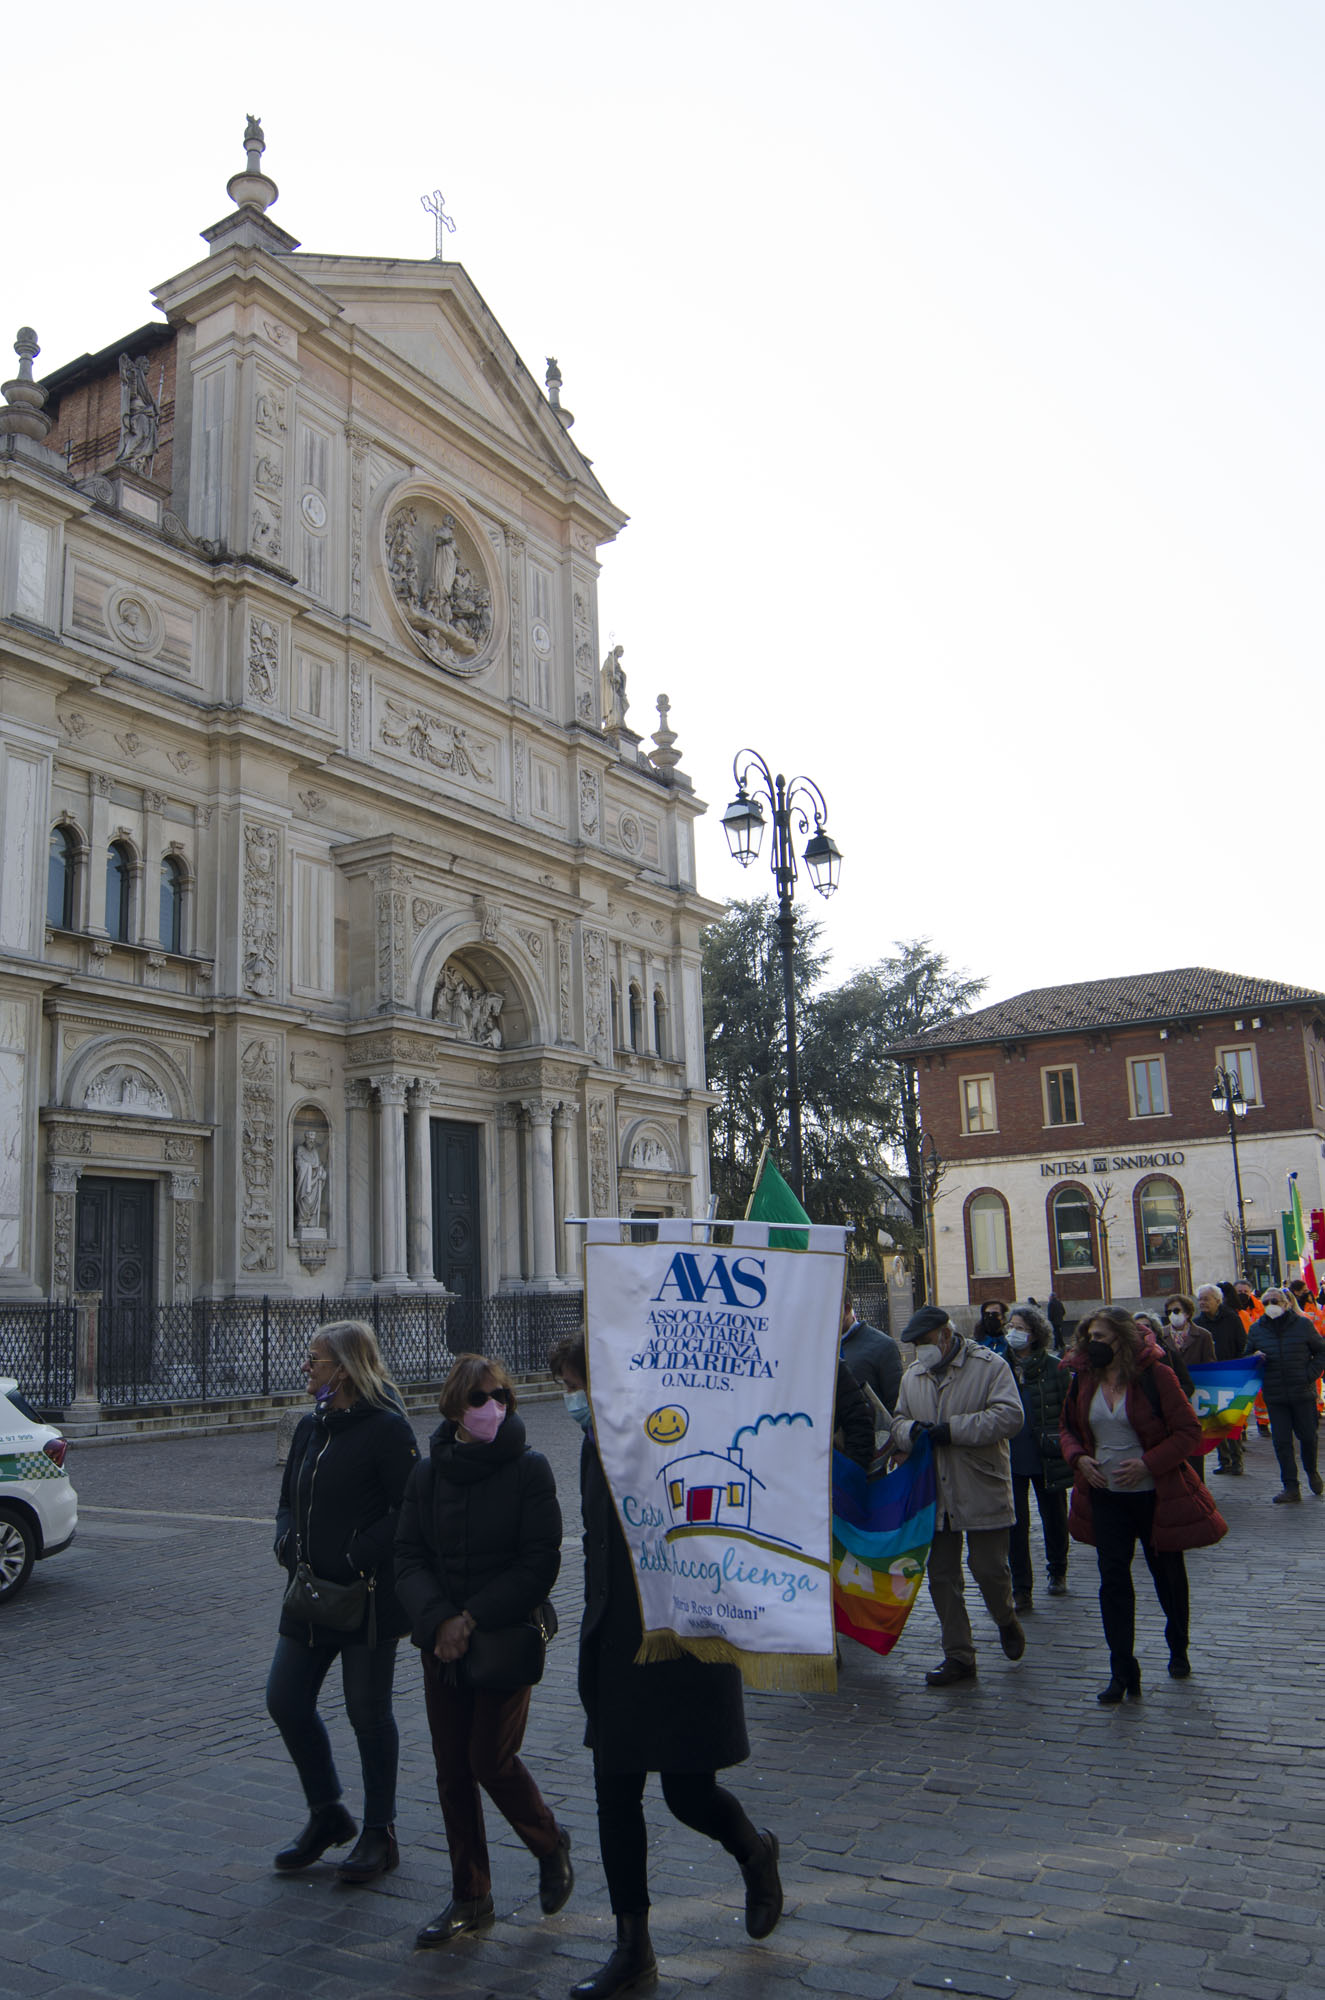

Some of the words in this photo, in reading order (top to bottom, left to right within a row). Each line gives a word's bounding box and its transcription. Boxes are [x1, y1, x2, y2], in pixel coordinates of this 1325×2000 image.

[1040, 1161, 1088, 1177] INTESA
[1112, 1151, 1185, 1171] SANPAOLO
[650, 1251, 768, 1309] AVAS
[646, 1309, 769, 1332] ASSOCIAZIONE
[654, 1324, 757, 1345] VOLONTARIA
[646, 1338, 762, 1361] ACCOGLIENZA
[628, 1352, 779, 1379] SOLIDARIETA'
[661, 1373, 735, 1393] O.N.L.U.S.
[622, 1495, 665, 1528] Casa
[690, 1600, 713, 1616] Rosa
